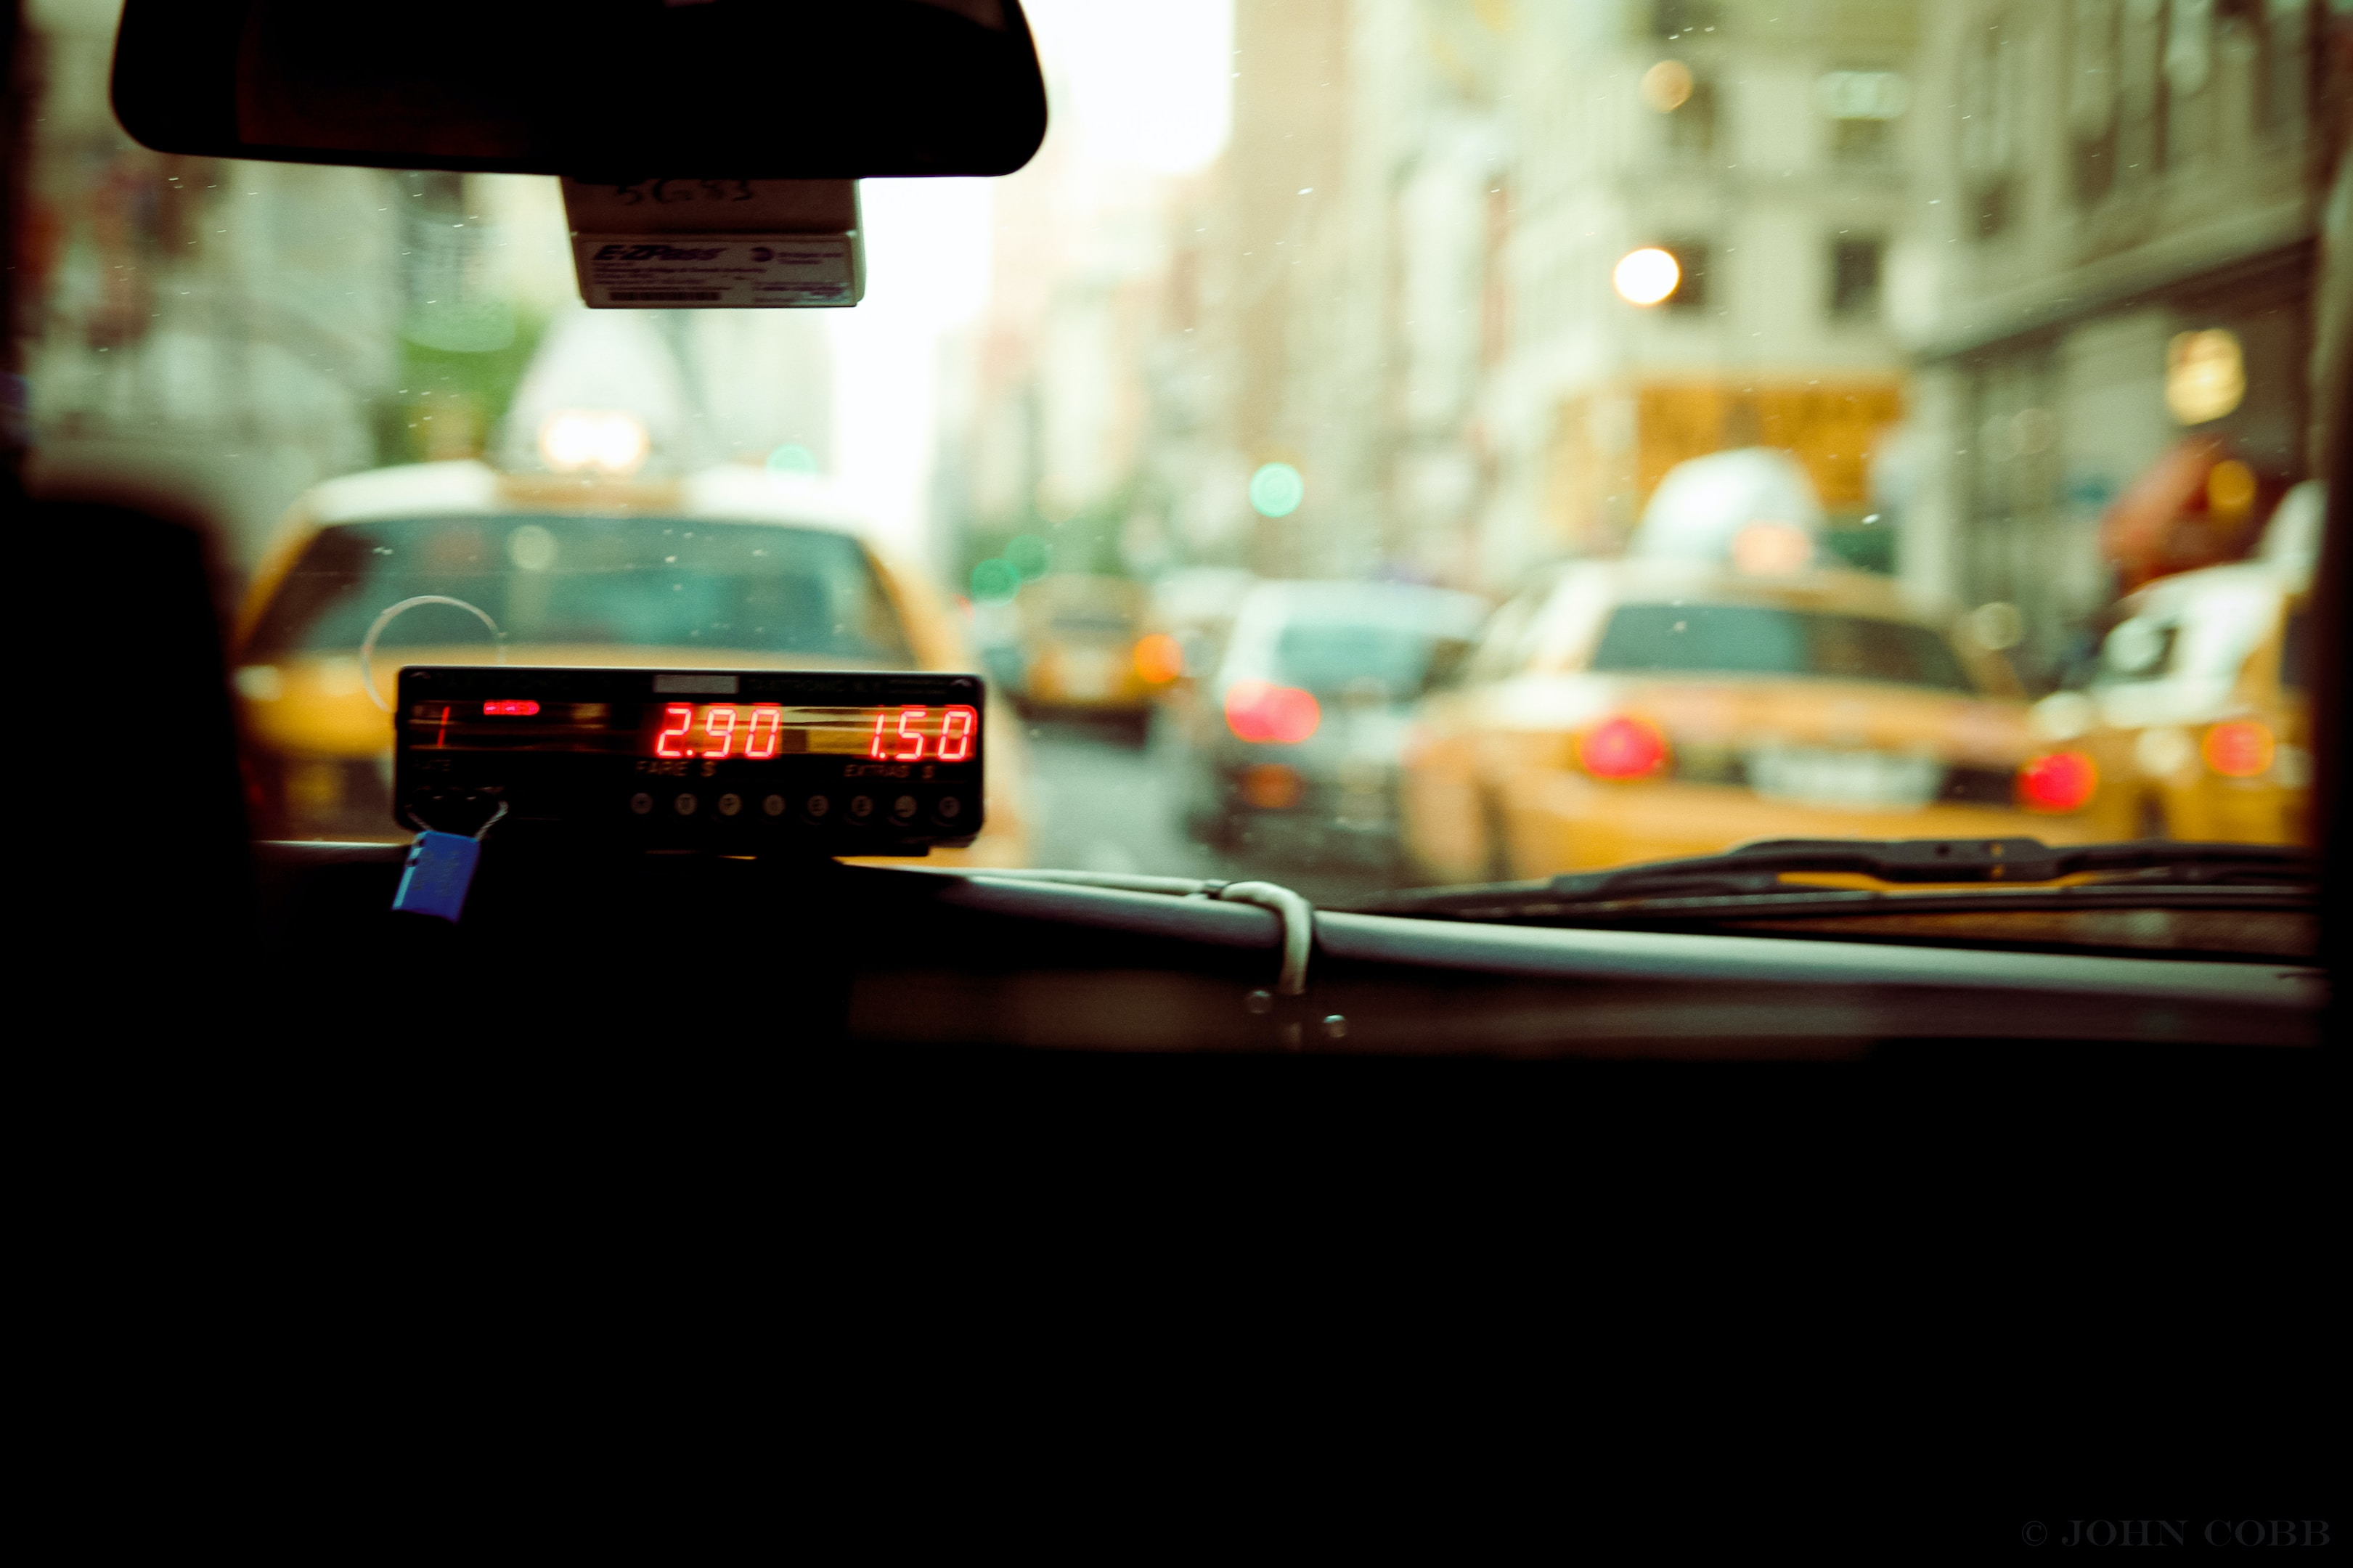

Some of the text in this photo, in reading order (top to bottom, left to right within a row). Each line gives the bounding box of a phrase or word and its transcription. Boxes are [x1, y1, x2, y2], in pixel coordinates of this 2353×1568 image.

[656, 708, 780, 757] 2.90
[871, 711, 973, 761] 1.50
[635, 760, 691, 776] FARE
